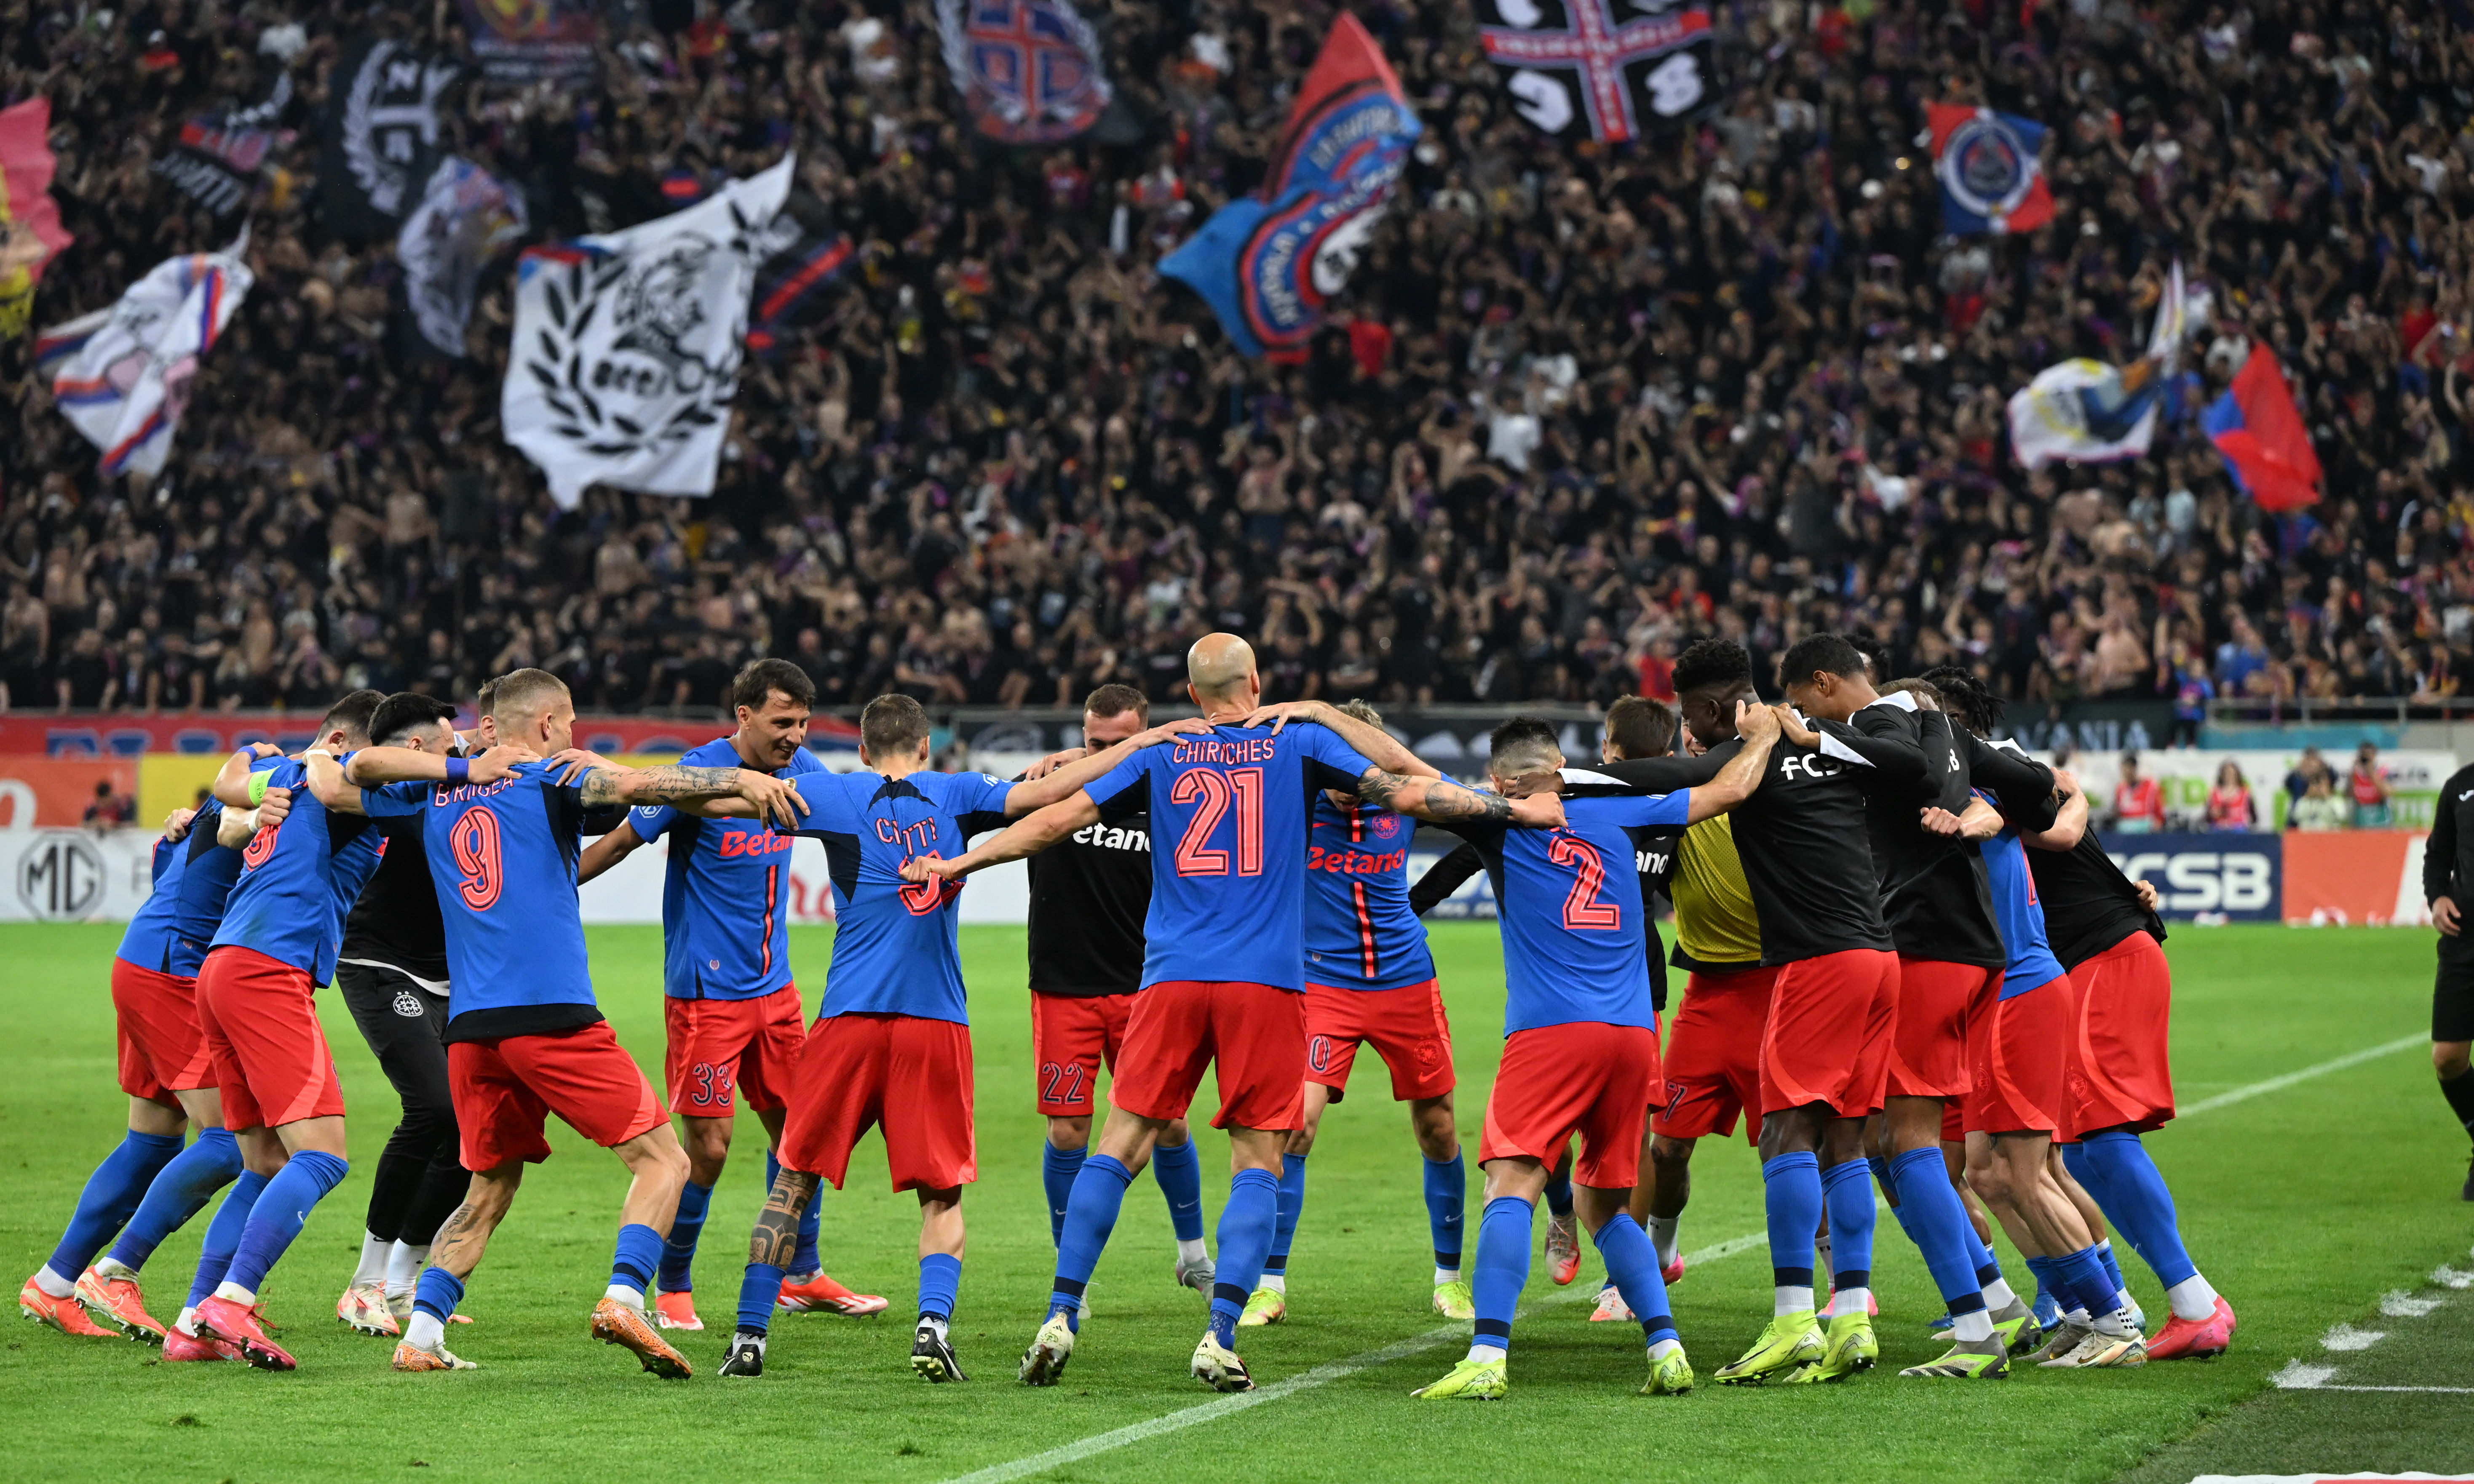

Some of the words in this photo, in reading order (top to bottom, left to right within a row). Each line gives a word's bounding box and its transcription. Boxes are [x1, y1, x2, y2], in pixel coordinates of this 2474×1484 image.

[1173, 738, 1275, 766] CHIRICHES
[719, 828, 795, 857] Betan
[1073, 822, 1150, 852] etan
[1171, 767, 1263, 877] 21
[27, 844, 95, 913] MG
[450, 806, 503, 911] 9
[1548, 836, 1620, 930] 2
[690, 1062, 732, 1107] 33
[1042, 1062, 1084, 1105] 22
[1662, 1081, 1688, 1122] 7
